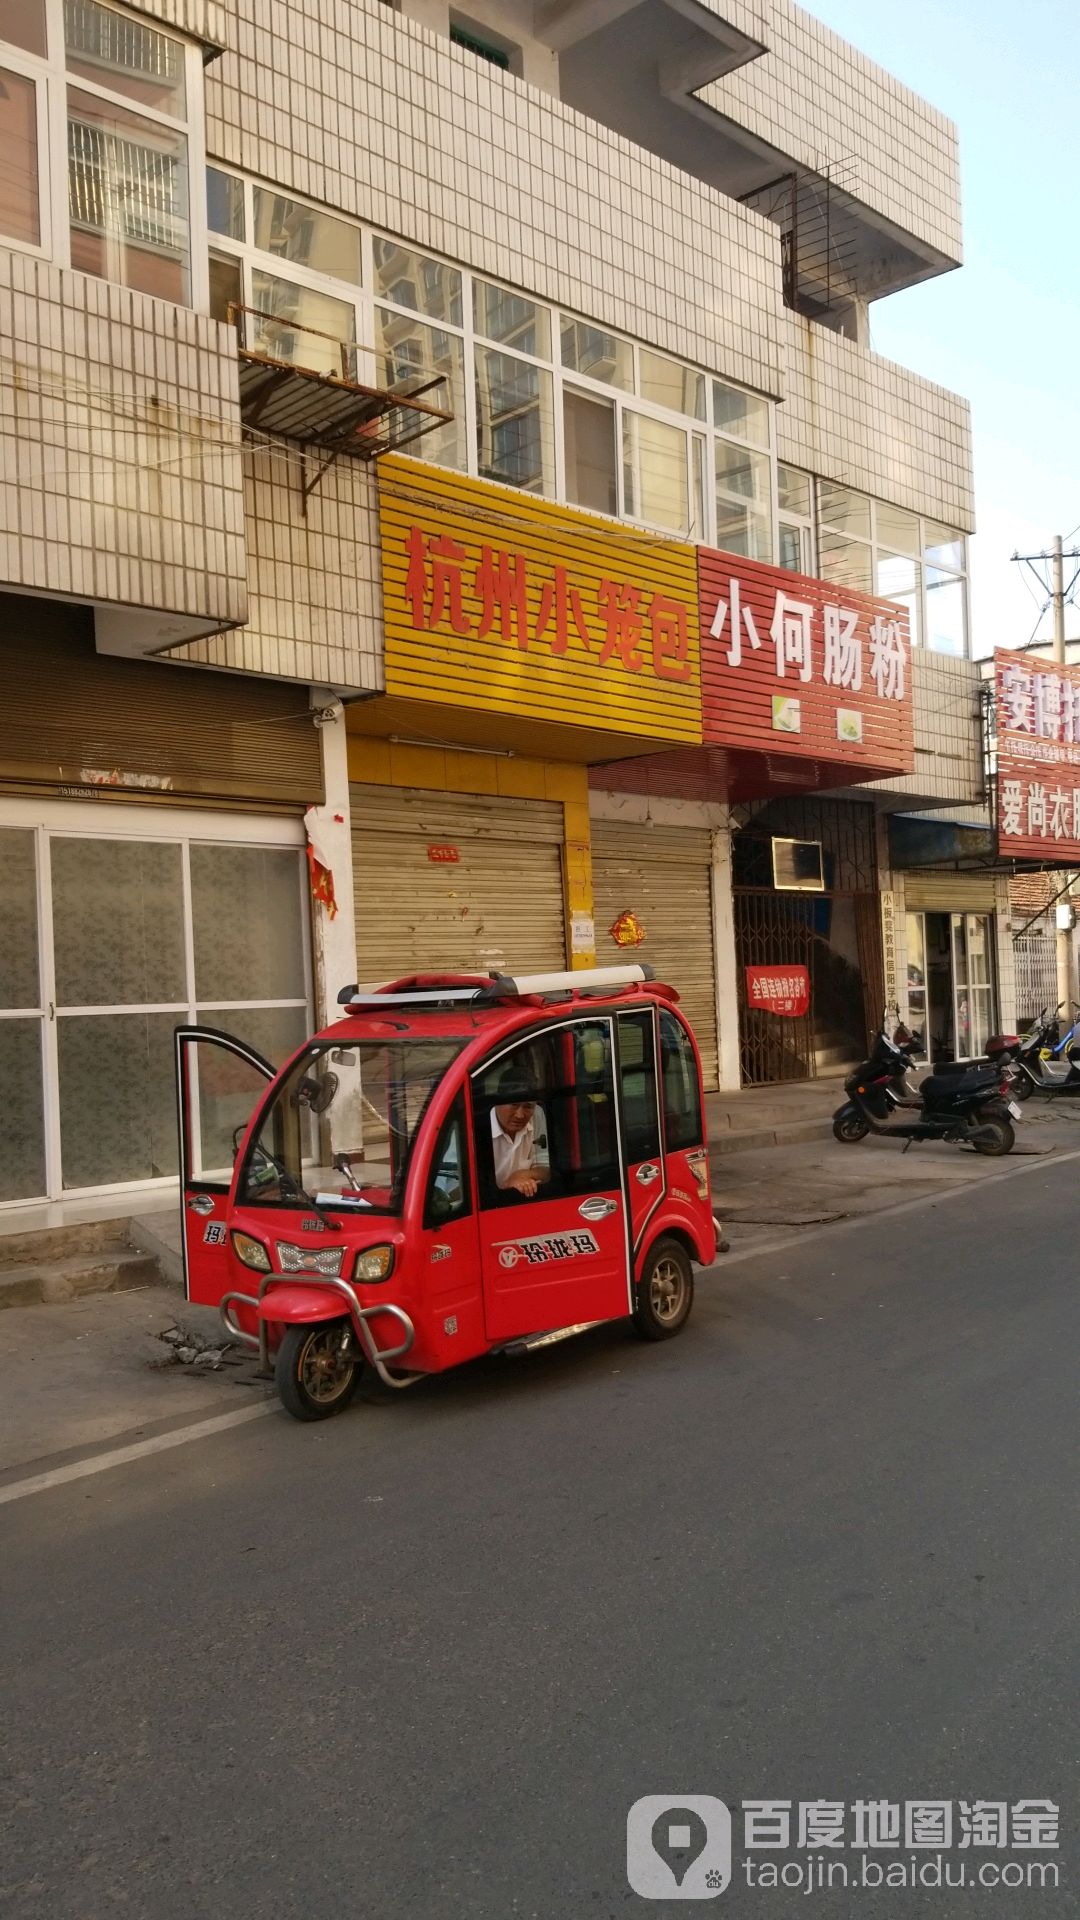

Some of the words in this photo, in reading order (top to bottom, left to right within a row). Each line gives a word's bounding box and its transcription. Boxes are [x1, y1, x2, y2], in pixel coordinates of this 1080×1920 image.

[404, 526, 692, 682] 杭州小笼包
[710, 578, 906, 701] 小何肠粉
